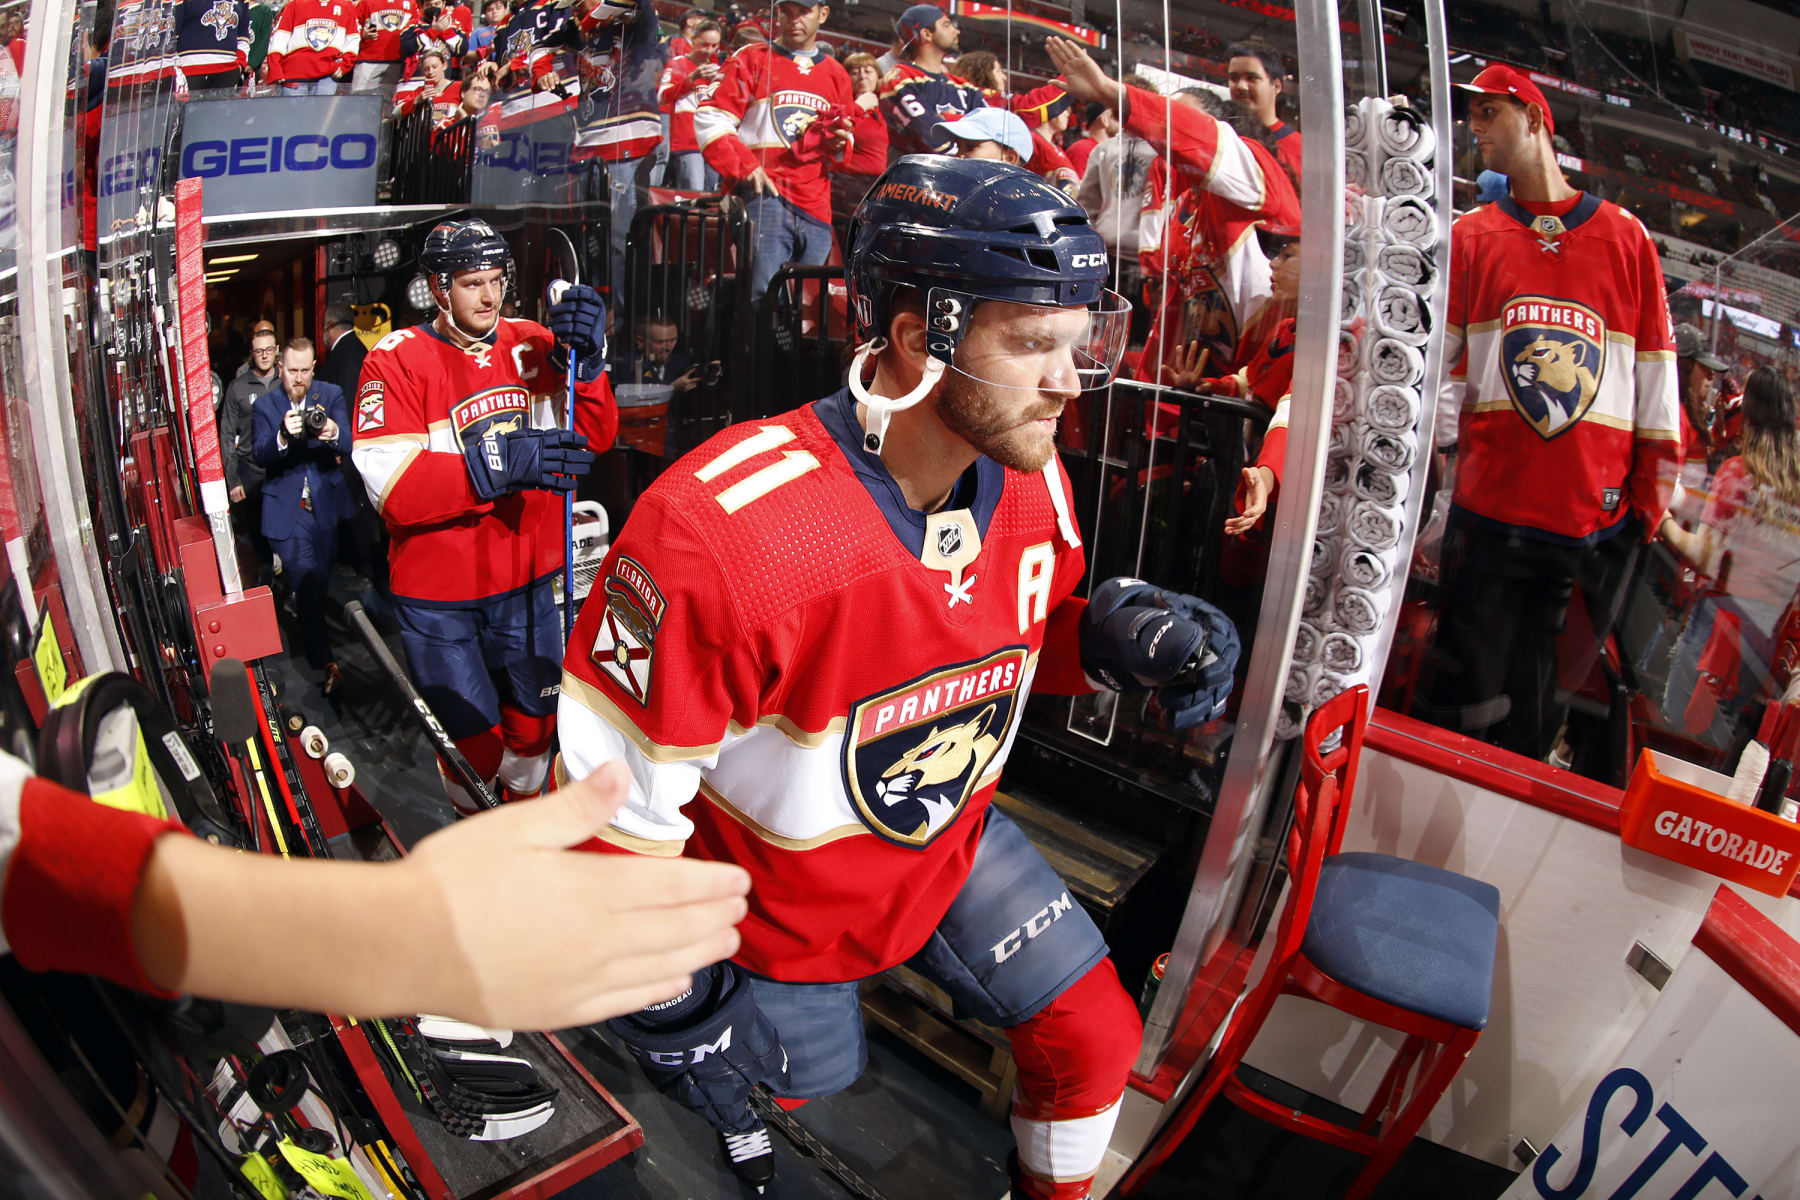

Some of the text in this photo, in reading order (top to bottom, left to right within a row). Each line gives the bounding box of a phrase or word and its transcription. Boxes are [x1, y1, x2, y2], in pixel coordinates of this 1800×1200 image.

[332, 5, 342, 16] A
[536, 12, 548, 28] C
[181, 132, 378, 179] GEICO
[1506, 307, 1596, 337] PANTHERS
[511, 342, 538, 381] C
[460, 393, 526, 424] PANTHERS
[693, 424, 823, 516] 11
[942, 527, 960, 552] NHL
[620, 564, 657, 611] FLORIDA
[1018, 541, 1056, 635] A
[874, 662, 1016, 733] PANTHERS
[413, 699, 457, 749] CCM
[1655, 810, 1793, 876] GATORADE
[989, 891, 1074, 965] CCM
[644, 987, 693, 1012] HUBERDEAU
[627, 1024, 733, 1067] CM
